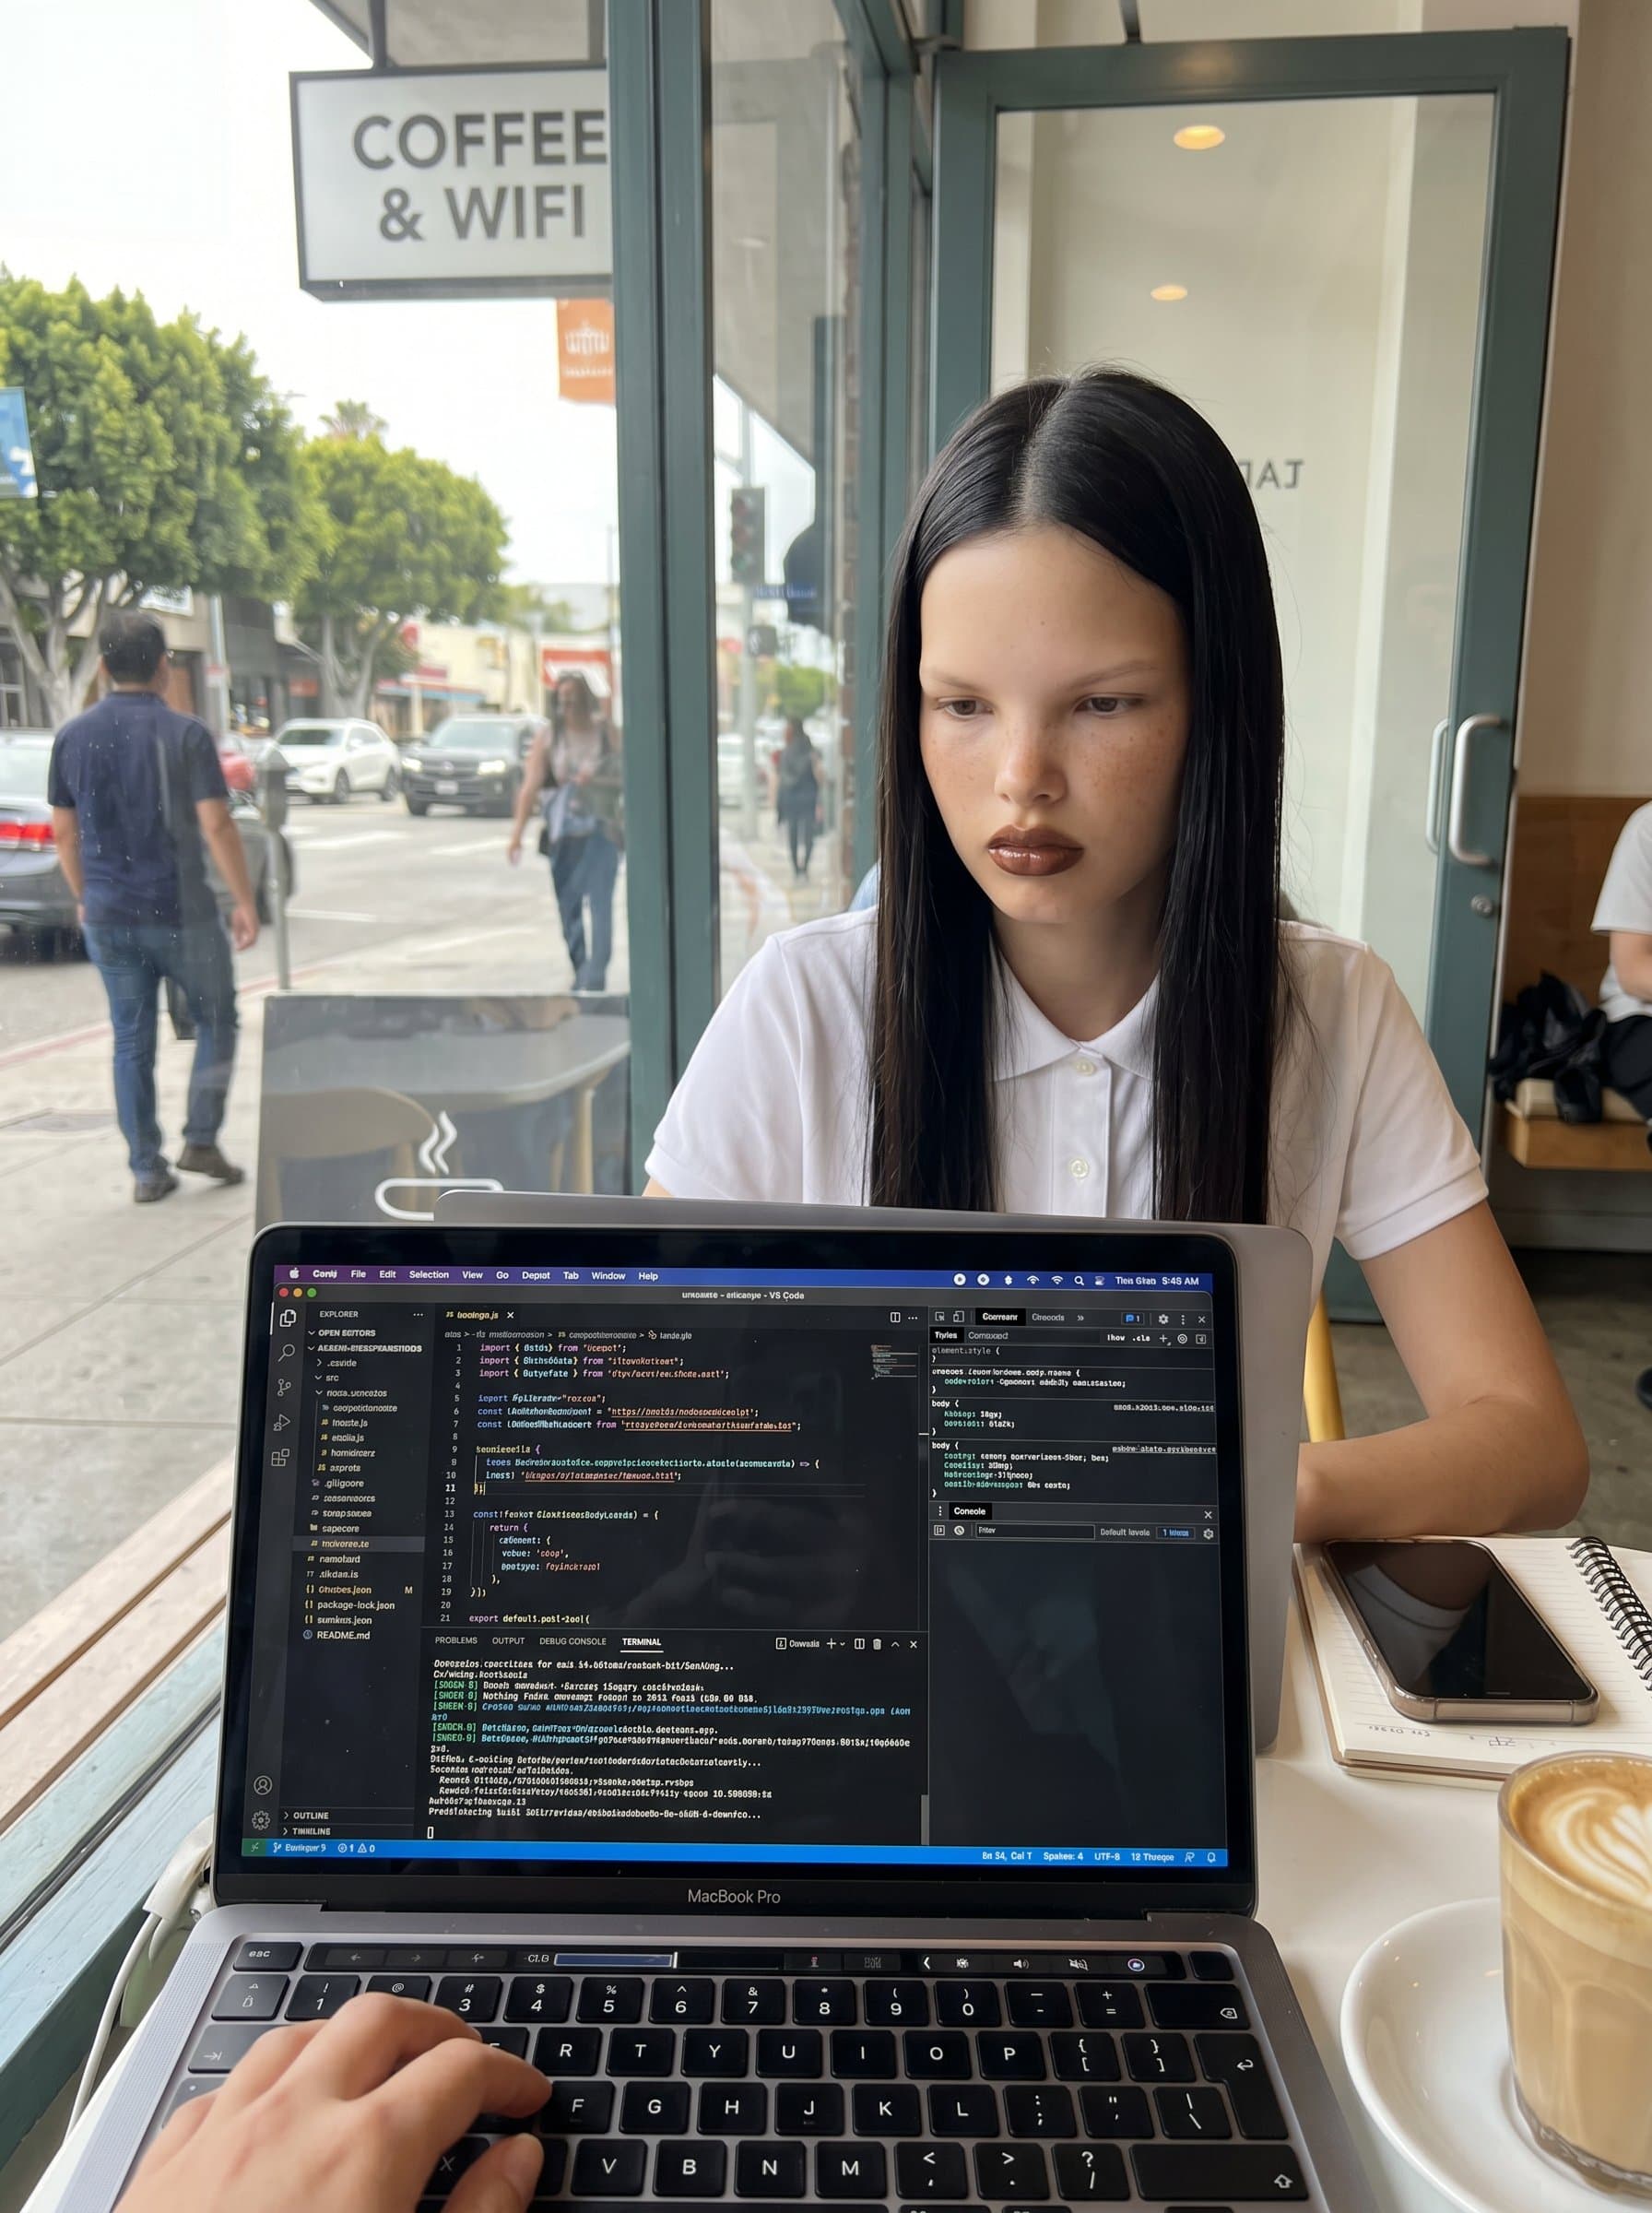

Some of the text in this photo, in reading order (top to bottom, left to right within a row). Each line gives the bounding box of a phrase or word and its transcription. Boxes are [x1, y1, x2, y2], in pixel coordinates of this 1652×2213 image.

[352, 109, 607, 170] COFFEE
[380, 184, 584, 242] & WIFI
[409, 1271, 449, 1279] Selection
[563, 1272, 579, 1280] Tab
[639, 1272, 658, 1281] Help
[317, 1631, 371, 1639] README.md
[492, 1637, 525, 1645] OUTPUT
[622, 1638, 661, 1646] TERMINAL
[688, 1889, 780, 1903] MacBook Pro
[249, 1949, 271, 1958] esc
[392, 1982, 404, 1993] @
[465, 1984, 474, 1993] #
[536, 1984, 545, 1994] $
[606, 1985, 617, 1994] %
[748, 1987, 759, 1996] &
[316, 1998, 324, 2010] 1
[459, 1999, 470, 2011] 3
[531, 2000, 542, 2011] 4
[603, 2000, 614, 2012] 5
[675, 2001, 687, 2013] 6
[748, 2001, 759, 2014] 7
[820, 2003, 830, 2015] 8
[891, 2003, 902, 2015] 9
[560, 2044, 572, 2057] R
[635, 2044, 646, 2057] T
[709, 2044, 721, 2058] Y
[783, 2045, 795, 2058] U
[861, 2046, 865, 2059] I
[930, 2047, 943, 2060] O
[1004, 2047, 1016, 2060] P
[572, 2099, 584, 2112] F
[648, 2100, 662, 2113] G
[725, 2101, 739, 2114] H
[804, 2101, 814, 2115] J
[879, 2101, 892, 2116] K
[957, 2102, 969, 2116] L
[1081, 2151, 1093, 2167] ?
[602, 2159, 618, 2174] V
[682, 2160, 696, 2175] B
[762, 2160, 777, 2175] N
[842, 2161, 859, 2176] M
